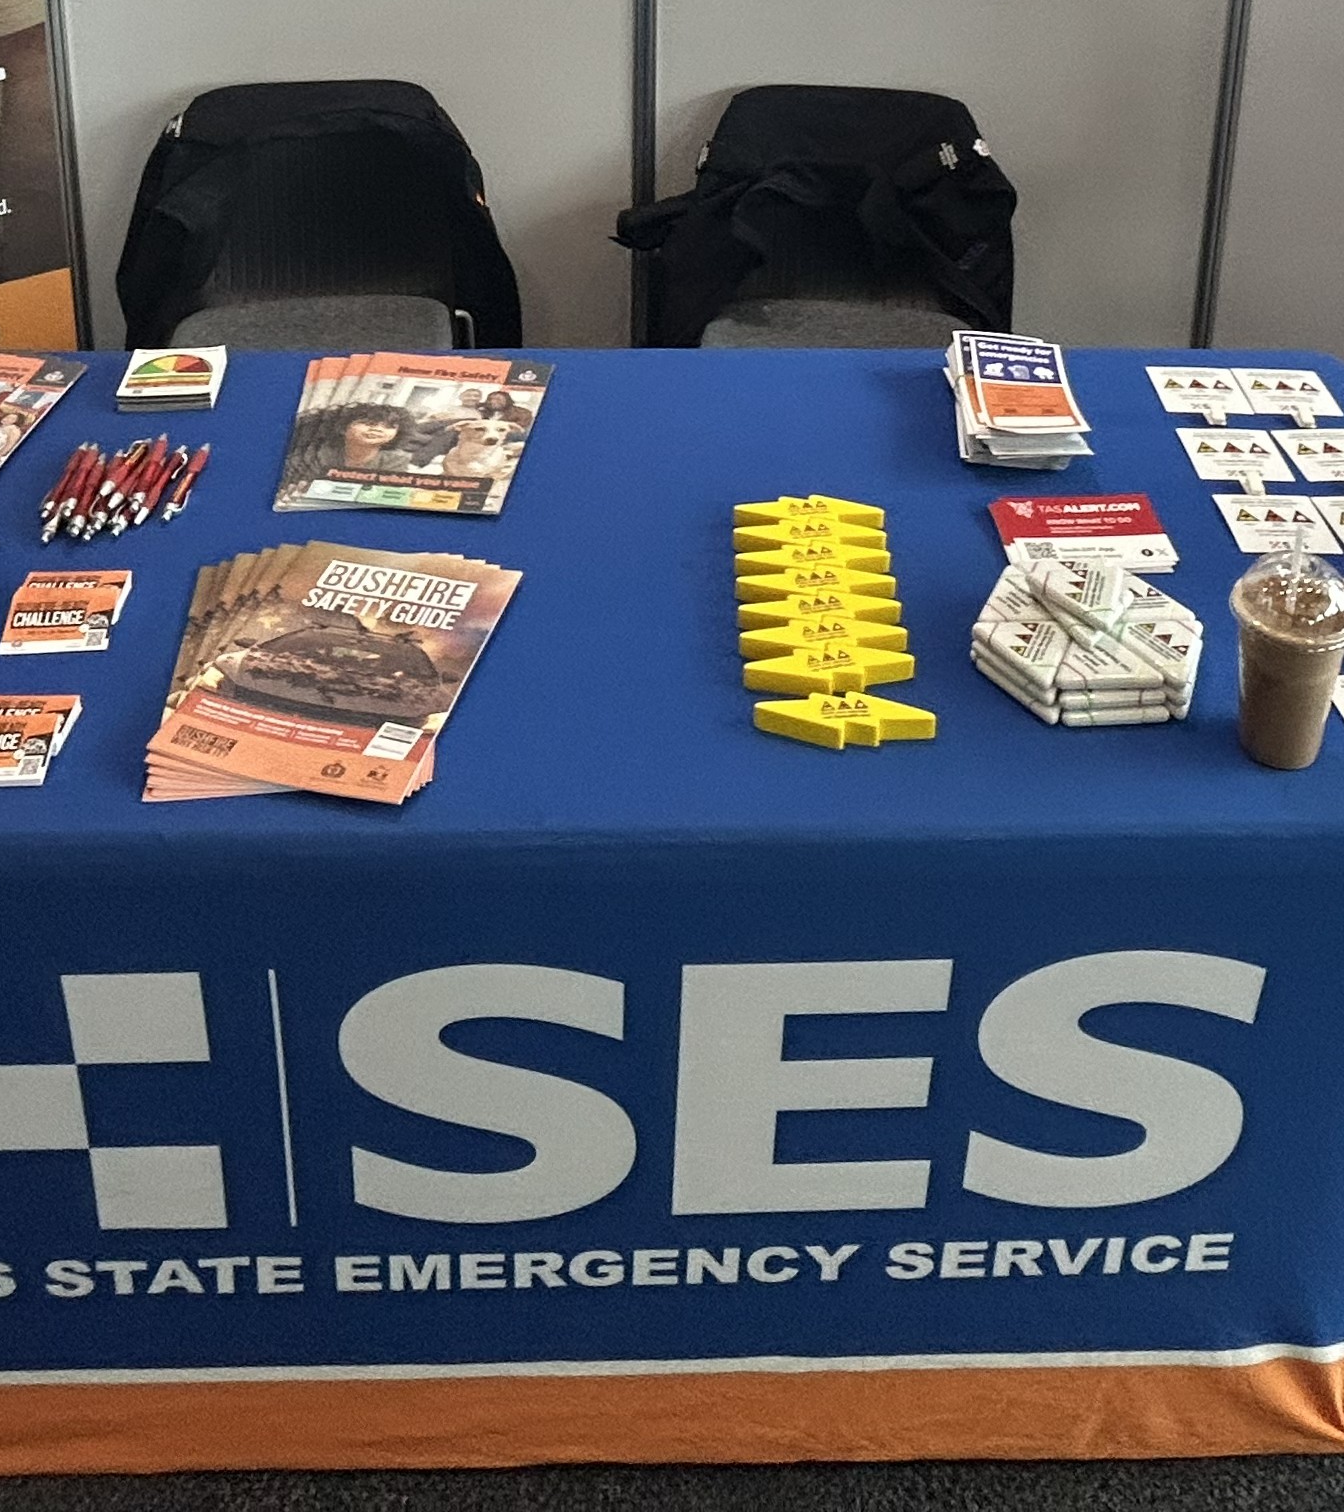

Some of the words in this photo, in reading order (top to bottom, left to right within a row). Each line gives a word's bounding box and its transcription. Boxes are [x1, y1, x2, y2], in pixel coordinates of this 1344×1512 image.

[398, 366, 433, 376] Home
[434, 369, 457, 378] Fire
[458, 370, 500, 381] Safety
[323, 563, 473, 607] BUSHFIRE
[13, 610, 86, 628] CHALLENGE
[301, 587, 396, 621] SAFETY
[389, 600, 462, 630] GUIDE
[337, 949, 1268, 1225] SES
[43, 1253, 306, 1297] STATE
[333, 1240, 862, 1294] EMERGENCY
[883, 1232, 1234, 1282] SERVICE
